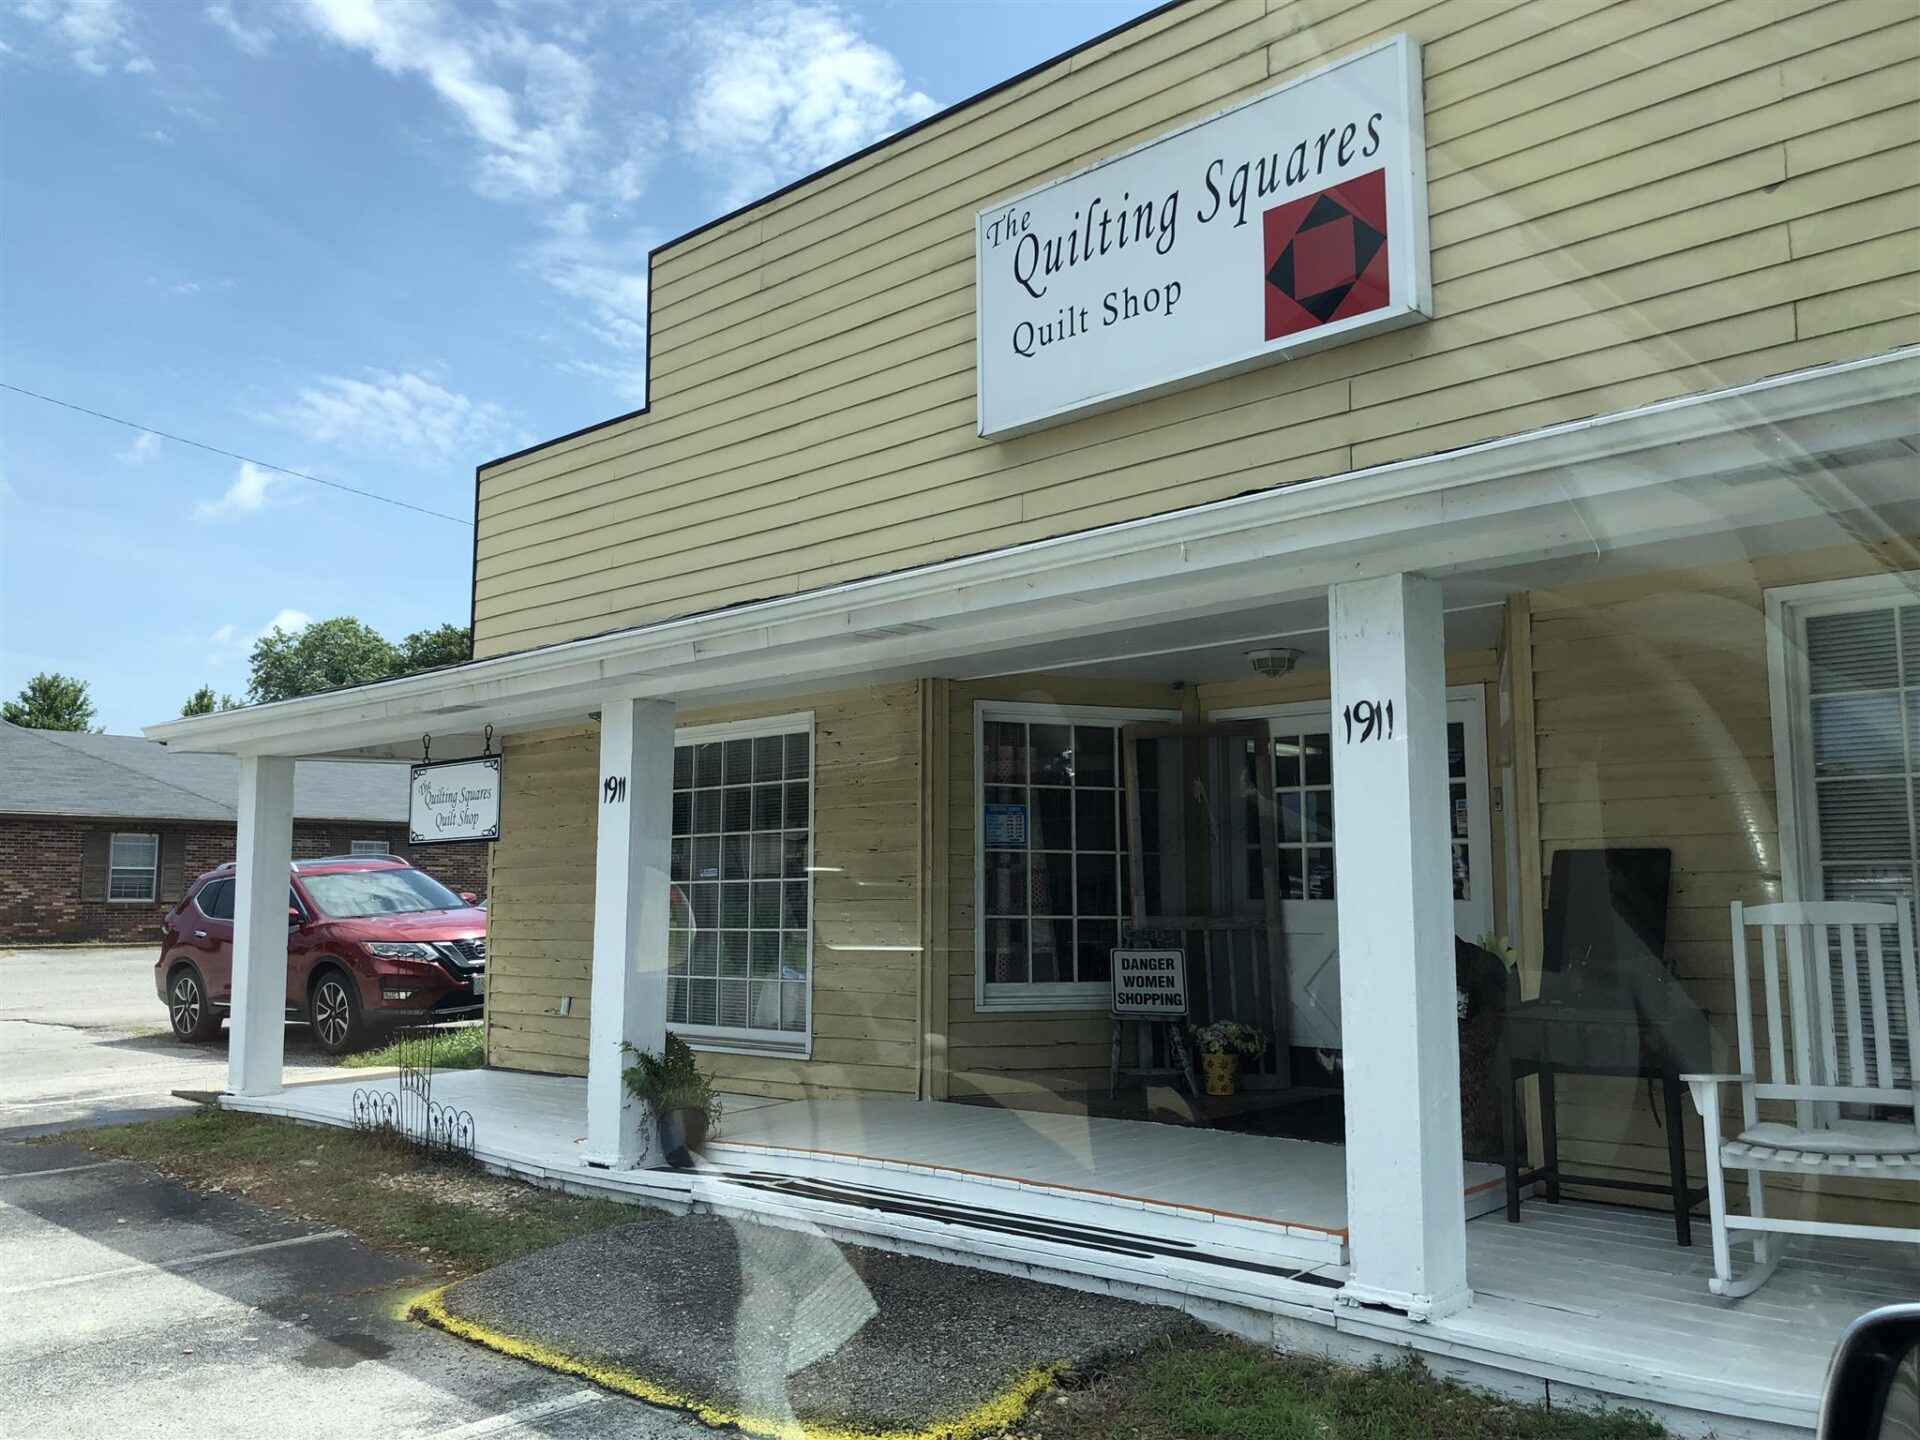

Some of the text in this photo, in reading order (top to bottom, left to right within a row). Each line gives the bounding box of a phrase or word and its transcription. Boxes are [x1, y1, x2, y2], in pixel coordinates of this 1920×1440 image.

[985, 112, 1383, 298] The Quilting Squares
[1012, 281, 1182, 358] Quilt Shop
[1343, 698, 1393, 744] 1911
[418, 780, 492, 810] The Quilting Squares
[604, 776, 626, 804] 1911
[435, 808, 479, 832] Quilt Shop
[1121, 958, 1175, 970] DANGER
[1122, 975, 1175, 988] WOMEN
[1117, 992, 1183, 1006] SHOPPING
